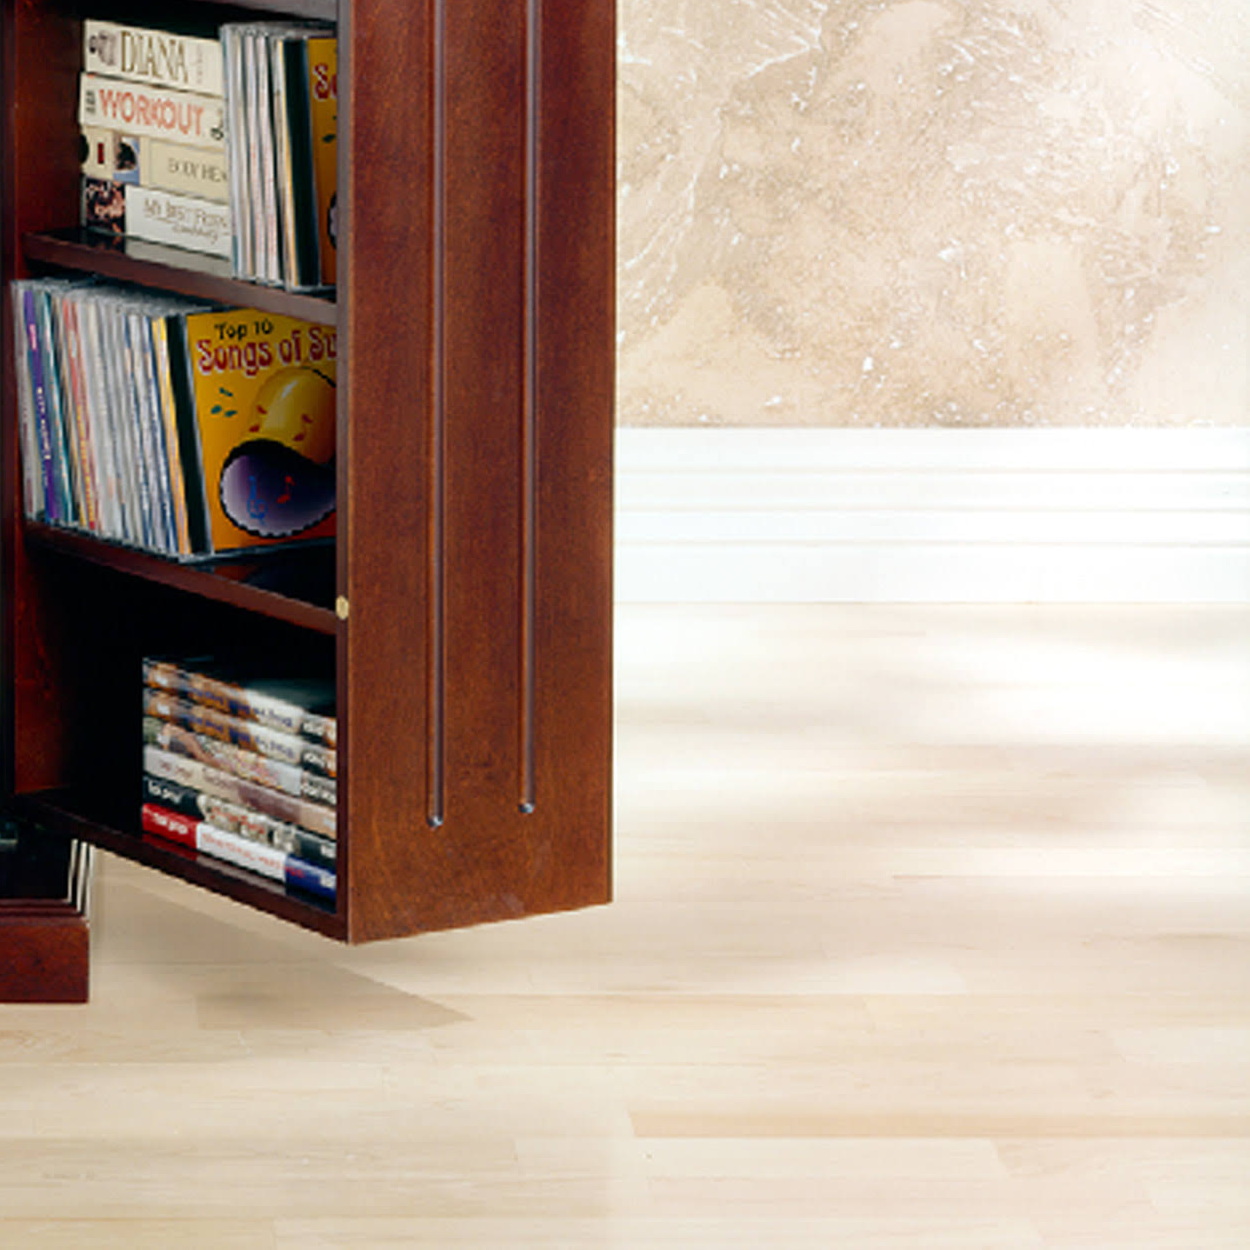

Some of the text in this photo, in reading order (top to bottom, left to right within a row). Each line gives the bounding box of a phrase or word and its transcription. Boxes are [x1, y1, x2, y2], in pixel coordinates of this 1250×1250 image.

[121, 29, 189, 84] DIANA
[99, 87, 205, 137] WORKOUT
[196, 338, 273, 377] Songs
[276, 329, 302, 366] of
[215, 318, 274, 341] Top 10
